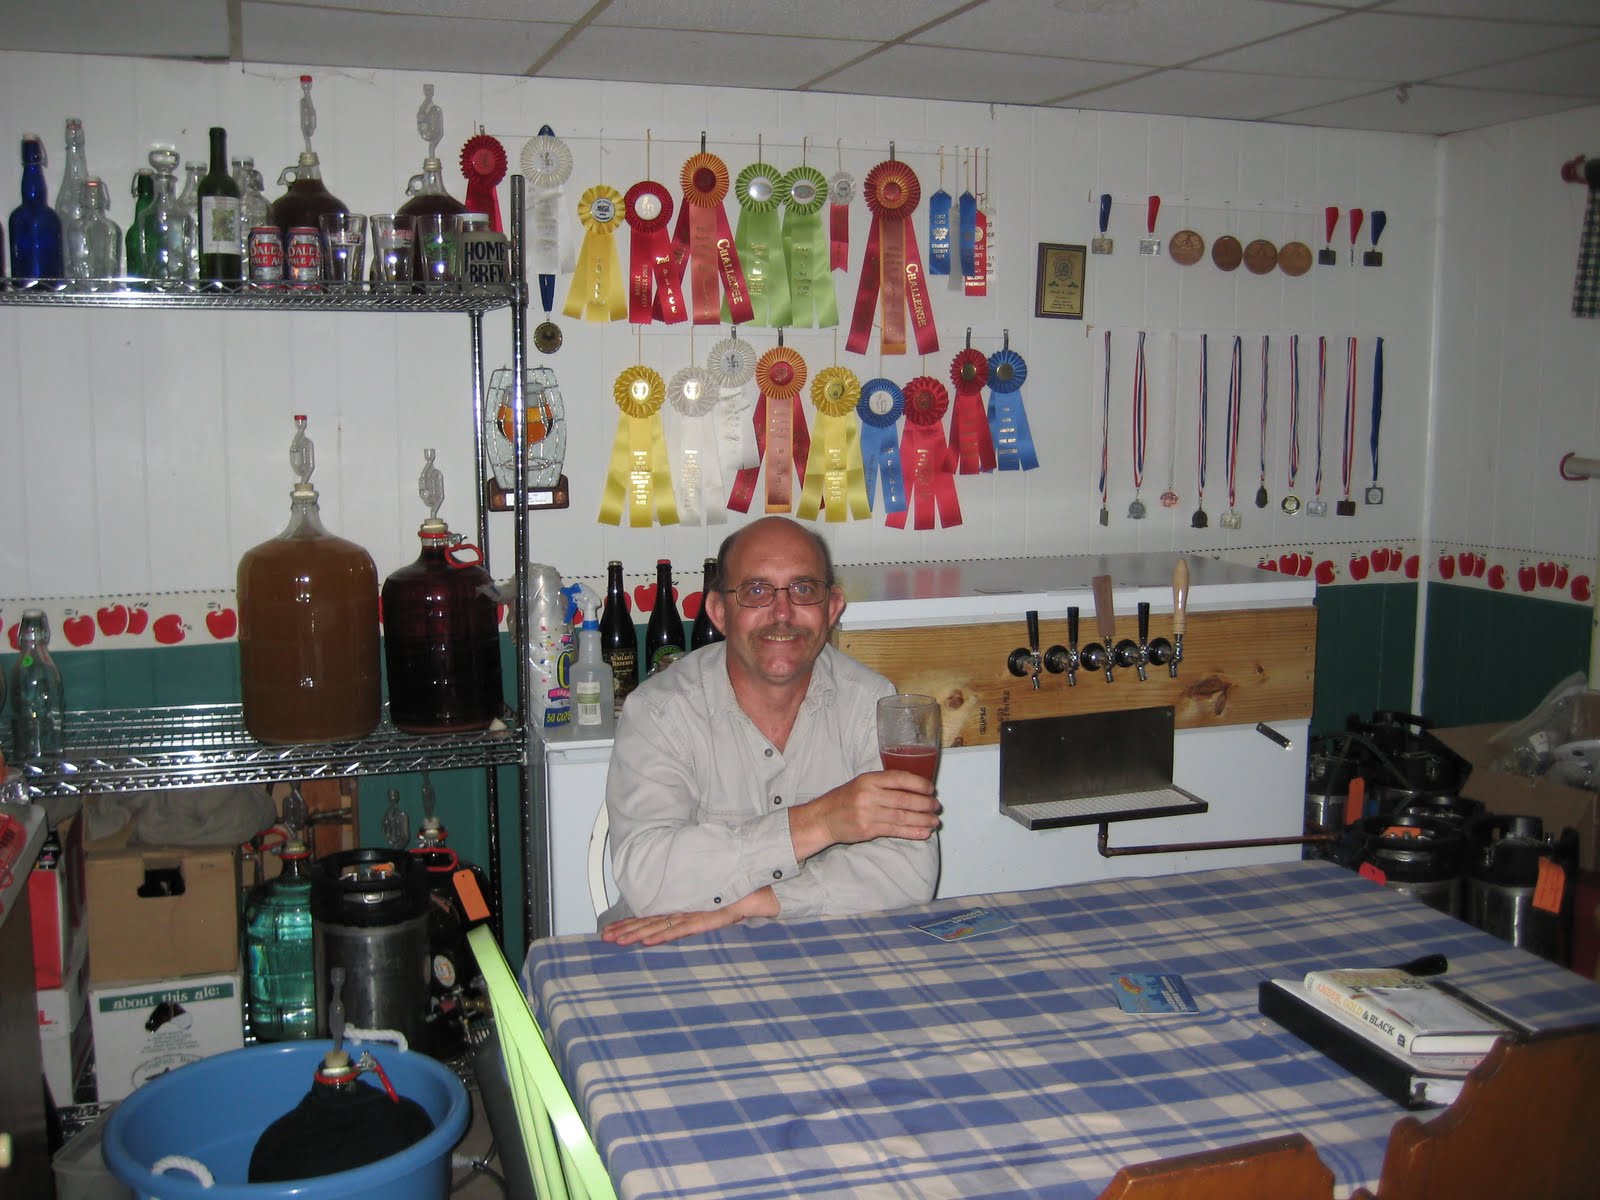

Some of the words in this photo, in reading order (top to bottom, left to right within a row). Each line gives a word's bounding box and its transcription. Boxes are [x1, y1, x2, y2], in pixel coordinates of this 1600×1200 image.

[250, 244, 284, 257] DALE'S
[464, 241, 505, 274] HOME
[655, 254, 670, 265] 2nd
[906, 263, 927, 328] CHALLENGE
[546, 713, 556, 722] 50
[113, 995, 154, 1010] about
[161, 990, 188, 1002] this
[194, 985, 220, 1000] ale:
[1362, 1010, 1370, 1021] &
[1368, 1014, 1396, 1036] BLACK
